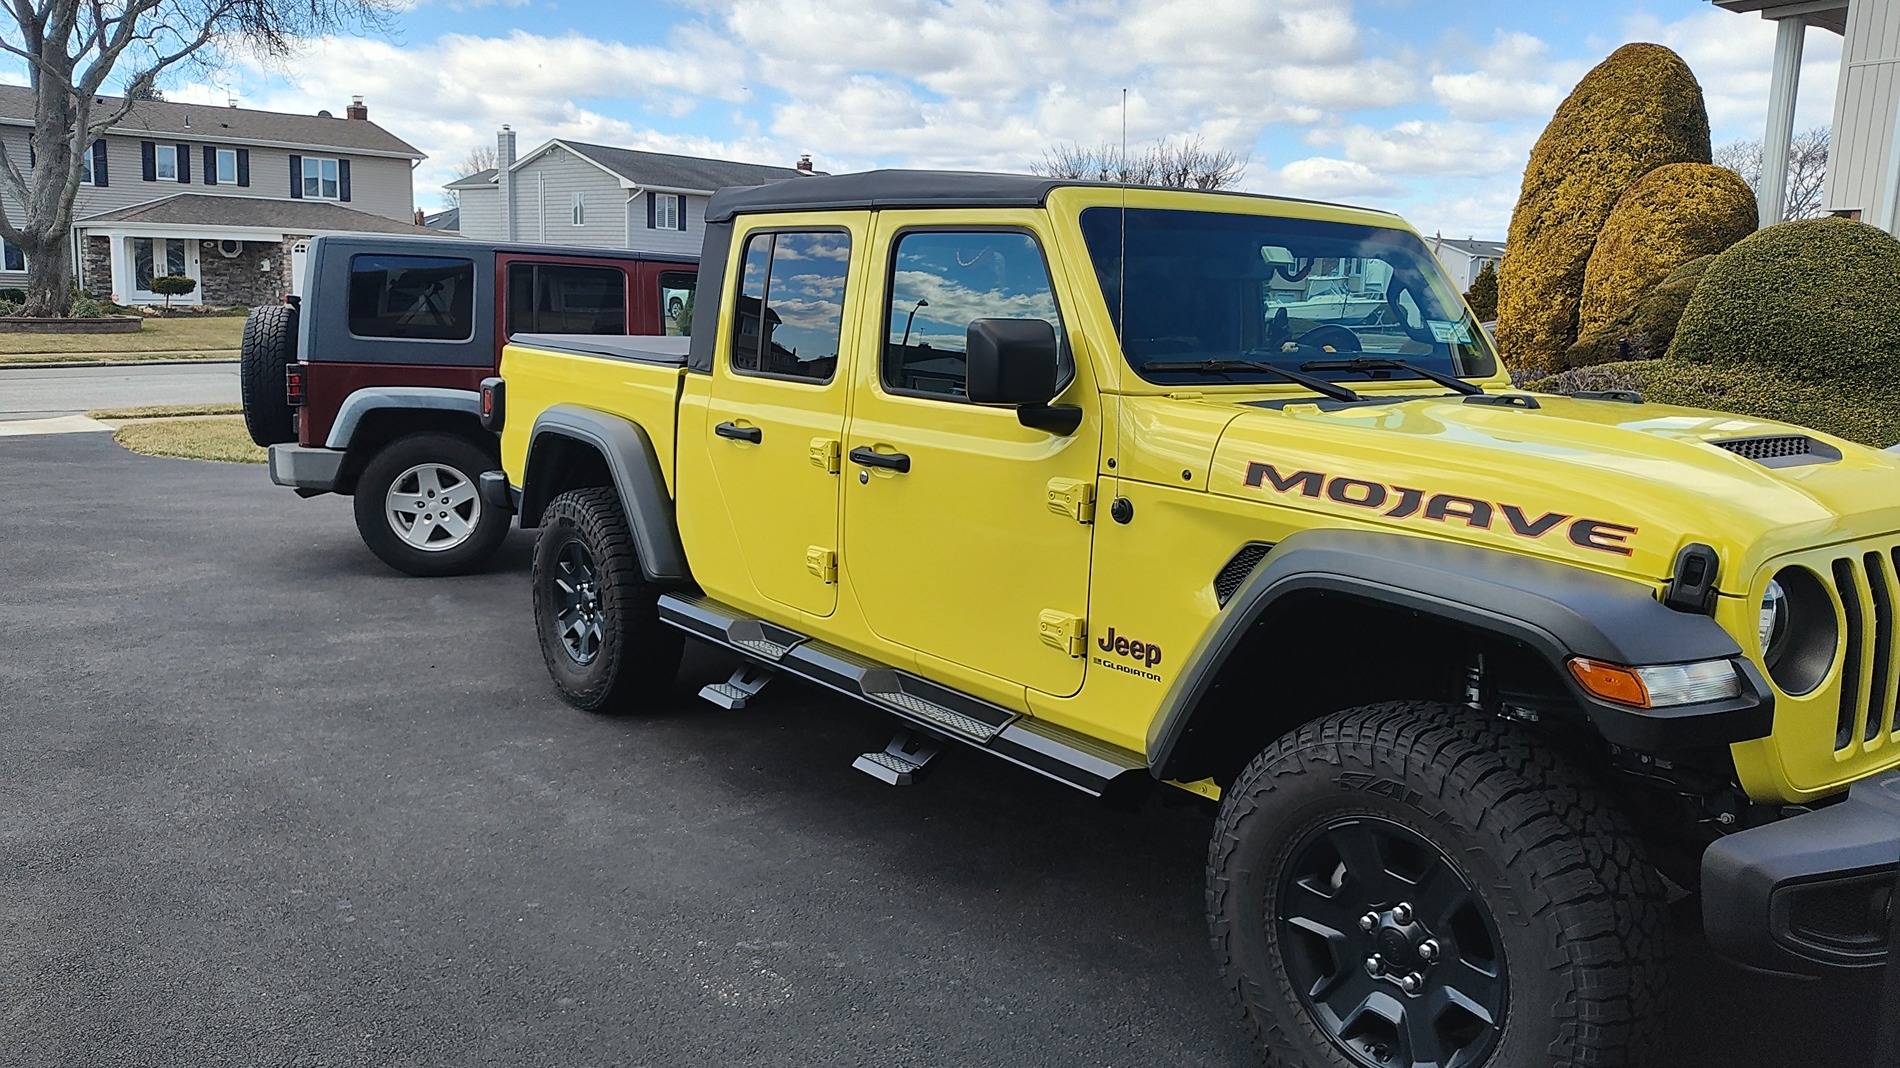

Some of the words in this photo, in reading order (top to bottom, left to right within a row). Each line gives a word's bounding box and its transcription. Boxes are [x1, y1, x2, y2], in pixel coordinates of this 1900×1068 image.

[1242, 460, 1638, 557] MOJAVE
[1098, 626, 1162, 668] Jeep
[1102, 660, 1162, 683] GLADIATOR
